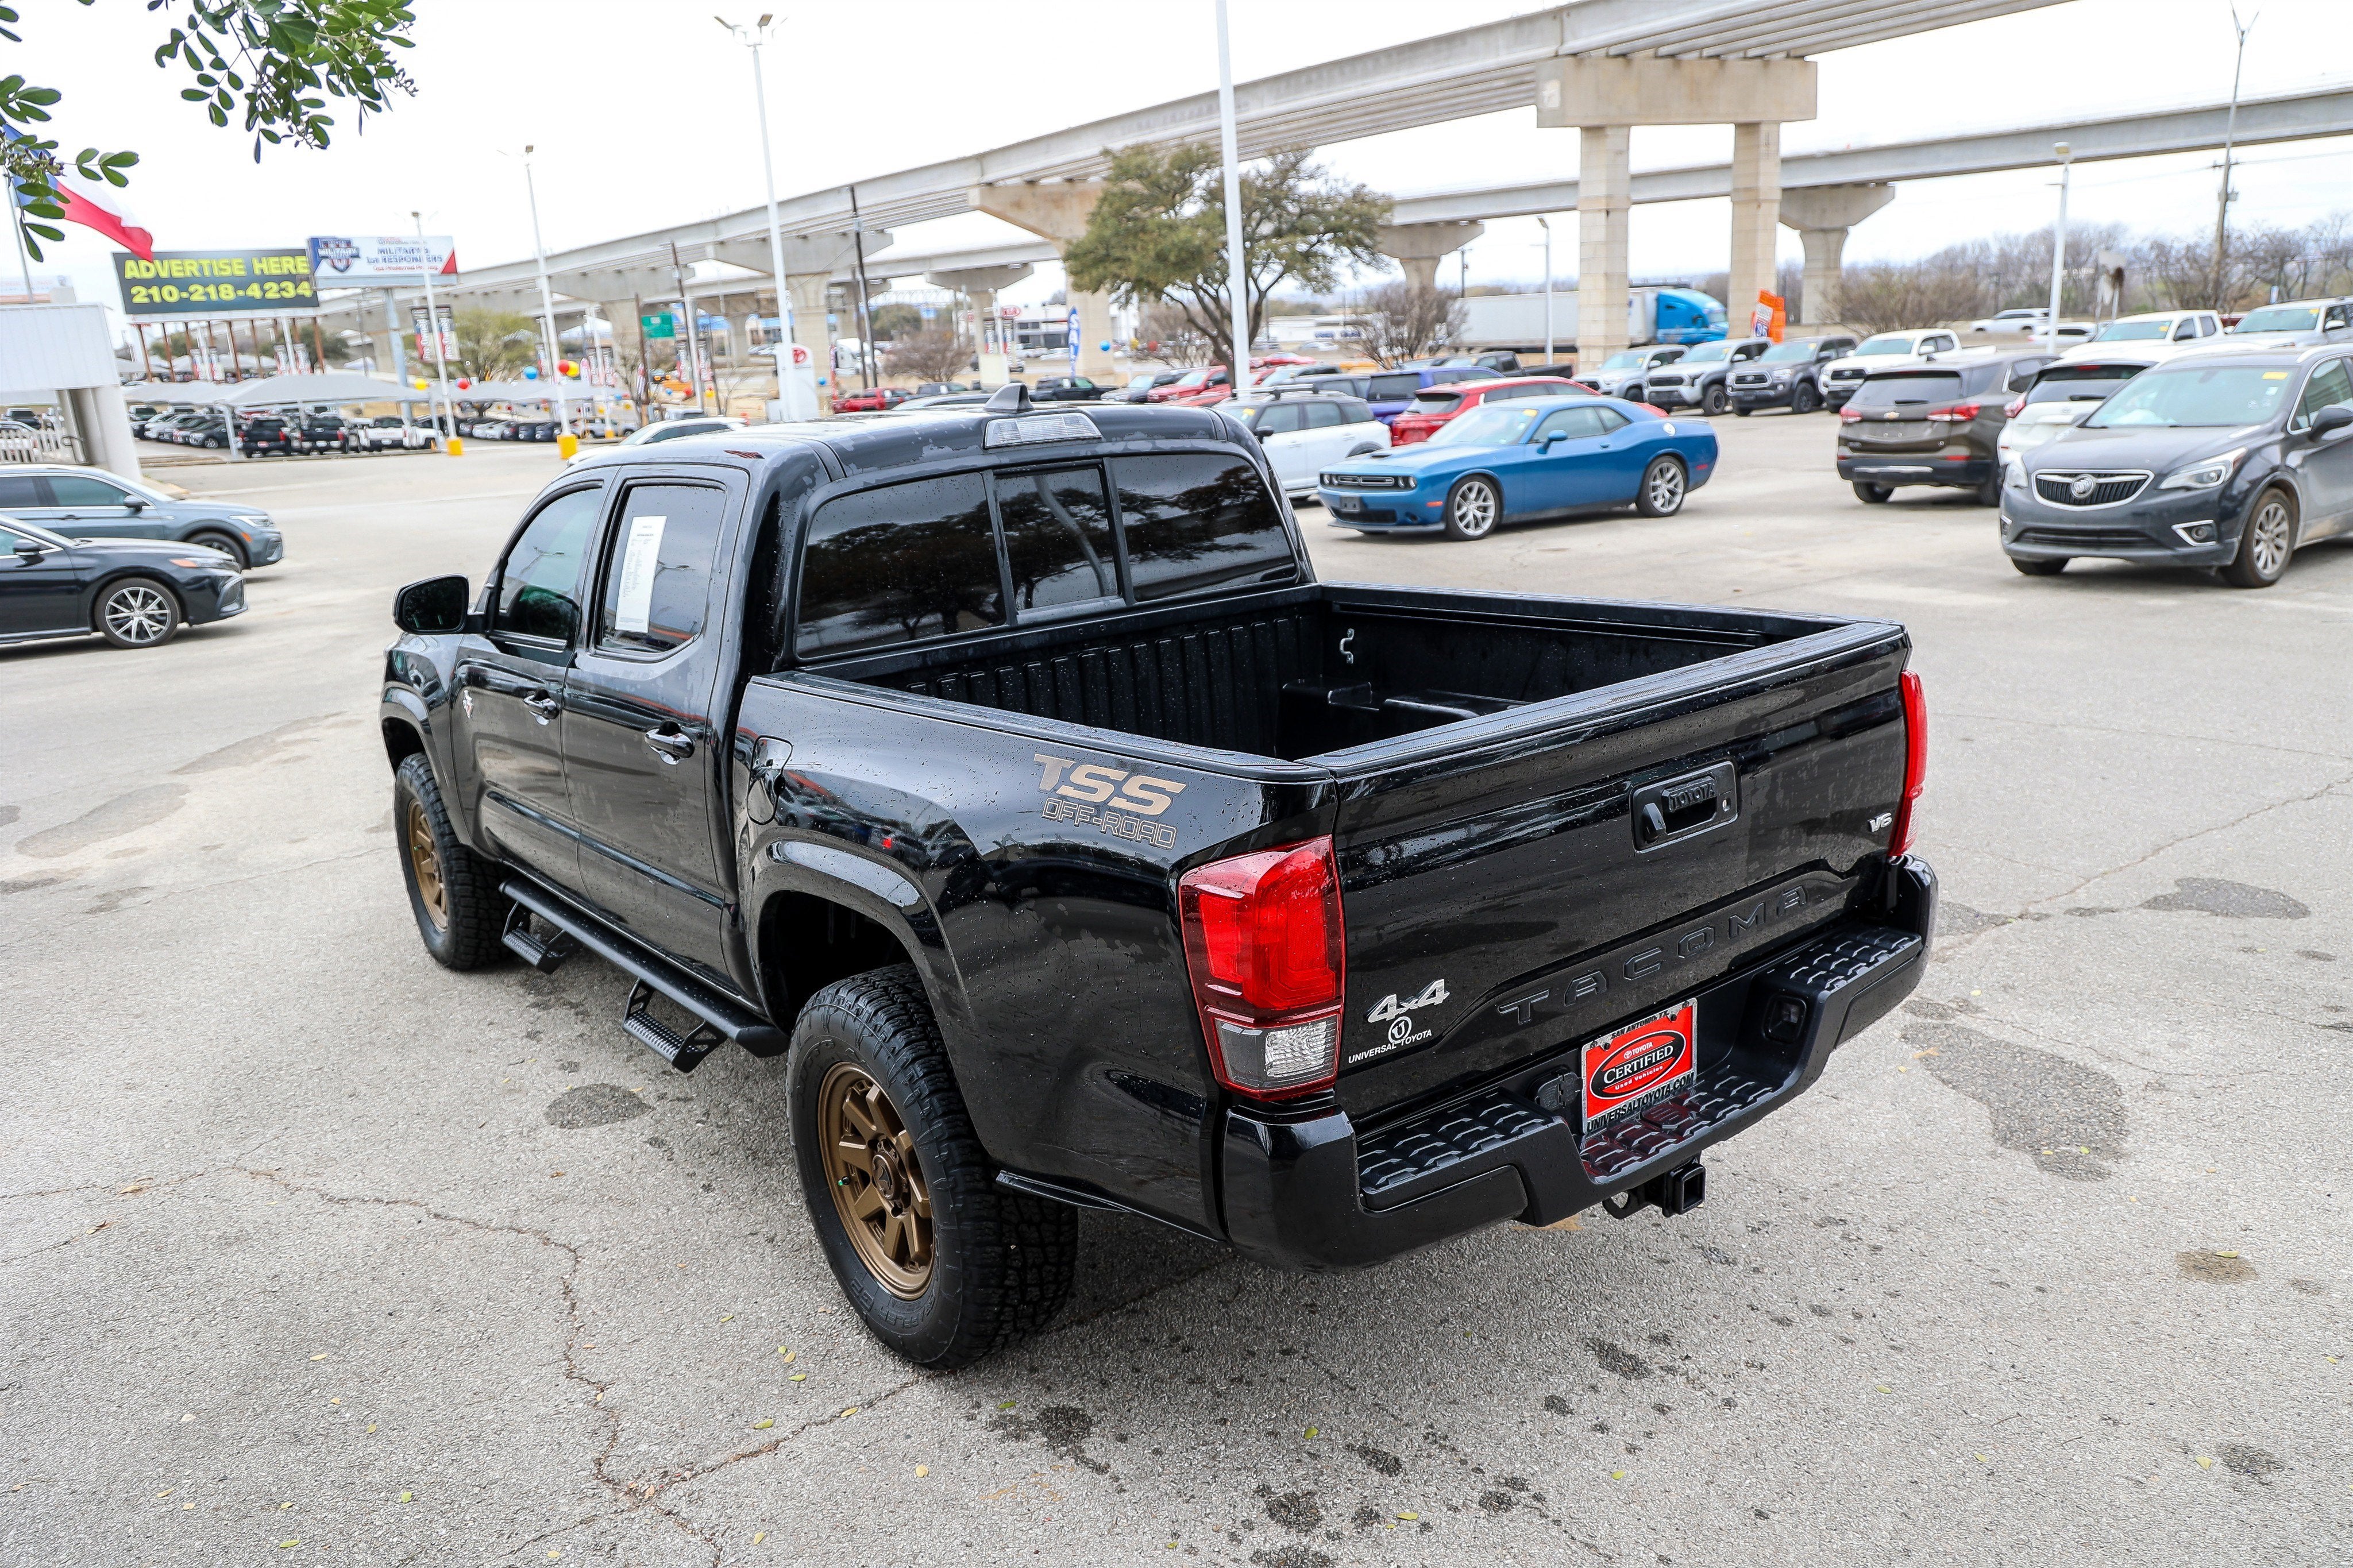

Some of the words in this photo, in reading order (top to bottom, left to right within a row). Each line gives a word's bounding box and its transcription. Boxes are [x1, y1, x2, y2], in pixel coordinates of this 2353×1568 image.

[124, 258, 247, 279] ADVERTISE
[252, 256, 311, 276] HERE
[381, 254, 442, 263] RESPONERS
[130, 280, 313, 303] 210-218-4234
[1033, 754, 1188, 816] TSS
[1668, 782, 1715, 812] TOYOTA
[1041, 797, 1177, 850] OFF-ROAD
[1868, 812, 1892, 833] V6
[1497, 885, 1809, 1025] TACOMA
[1365, 979, 1451, 1024] 4x4
[1611, 1030, 1626, 1040] SAN
[1658, 1010, 1669, 1019] TX
[1348, 1042, 1397, 1064] UNIVERSAL
[1398, 1029, 1432, 1046] TOYOTA
[1632, 1041, 1653, 1056] TOYOTA
[1604, 1045, 1673, 1084] CERTIFIED
[1615, 1079, 1633, 1091] Used
[1634, 1065, 1663, 1081] Vehicles
[1587, 1072, 1694, 1131] UNIVERSALTOYOTA.COM
